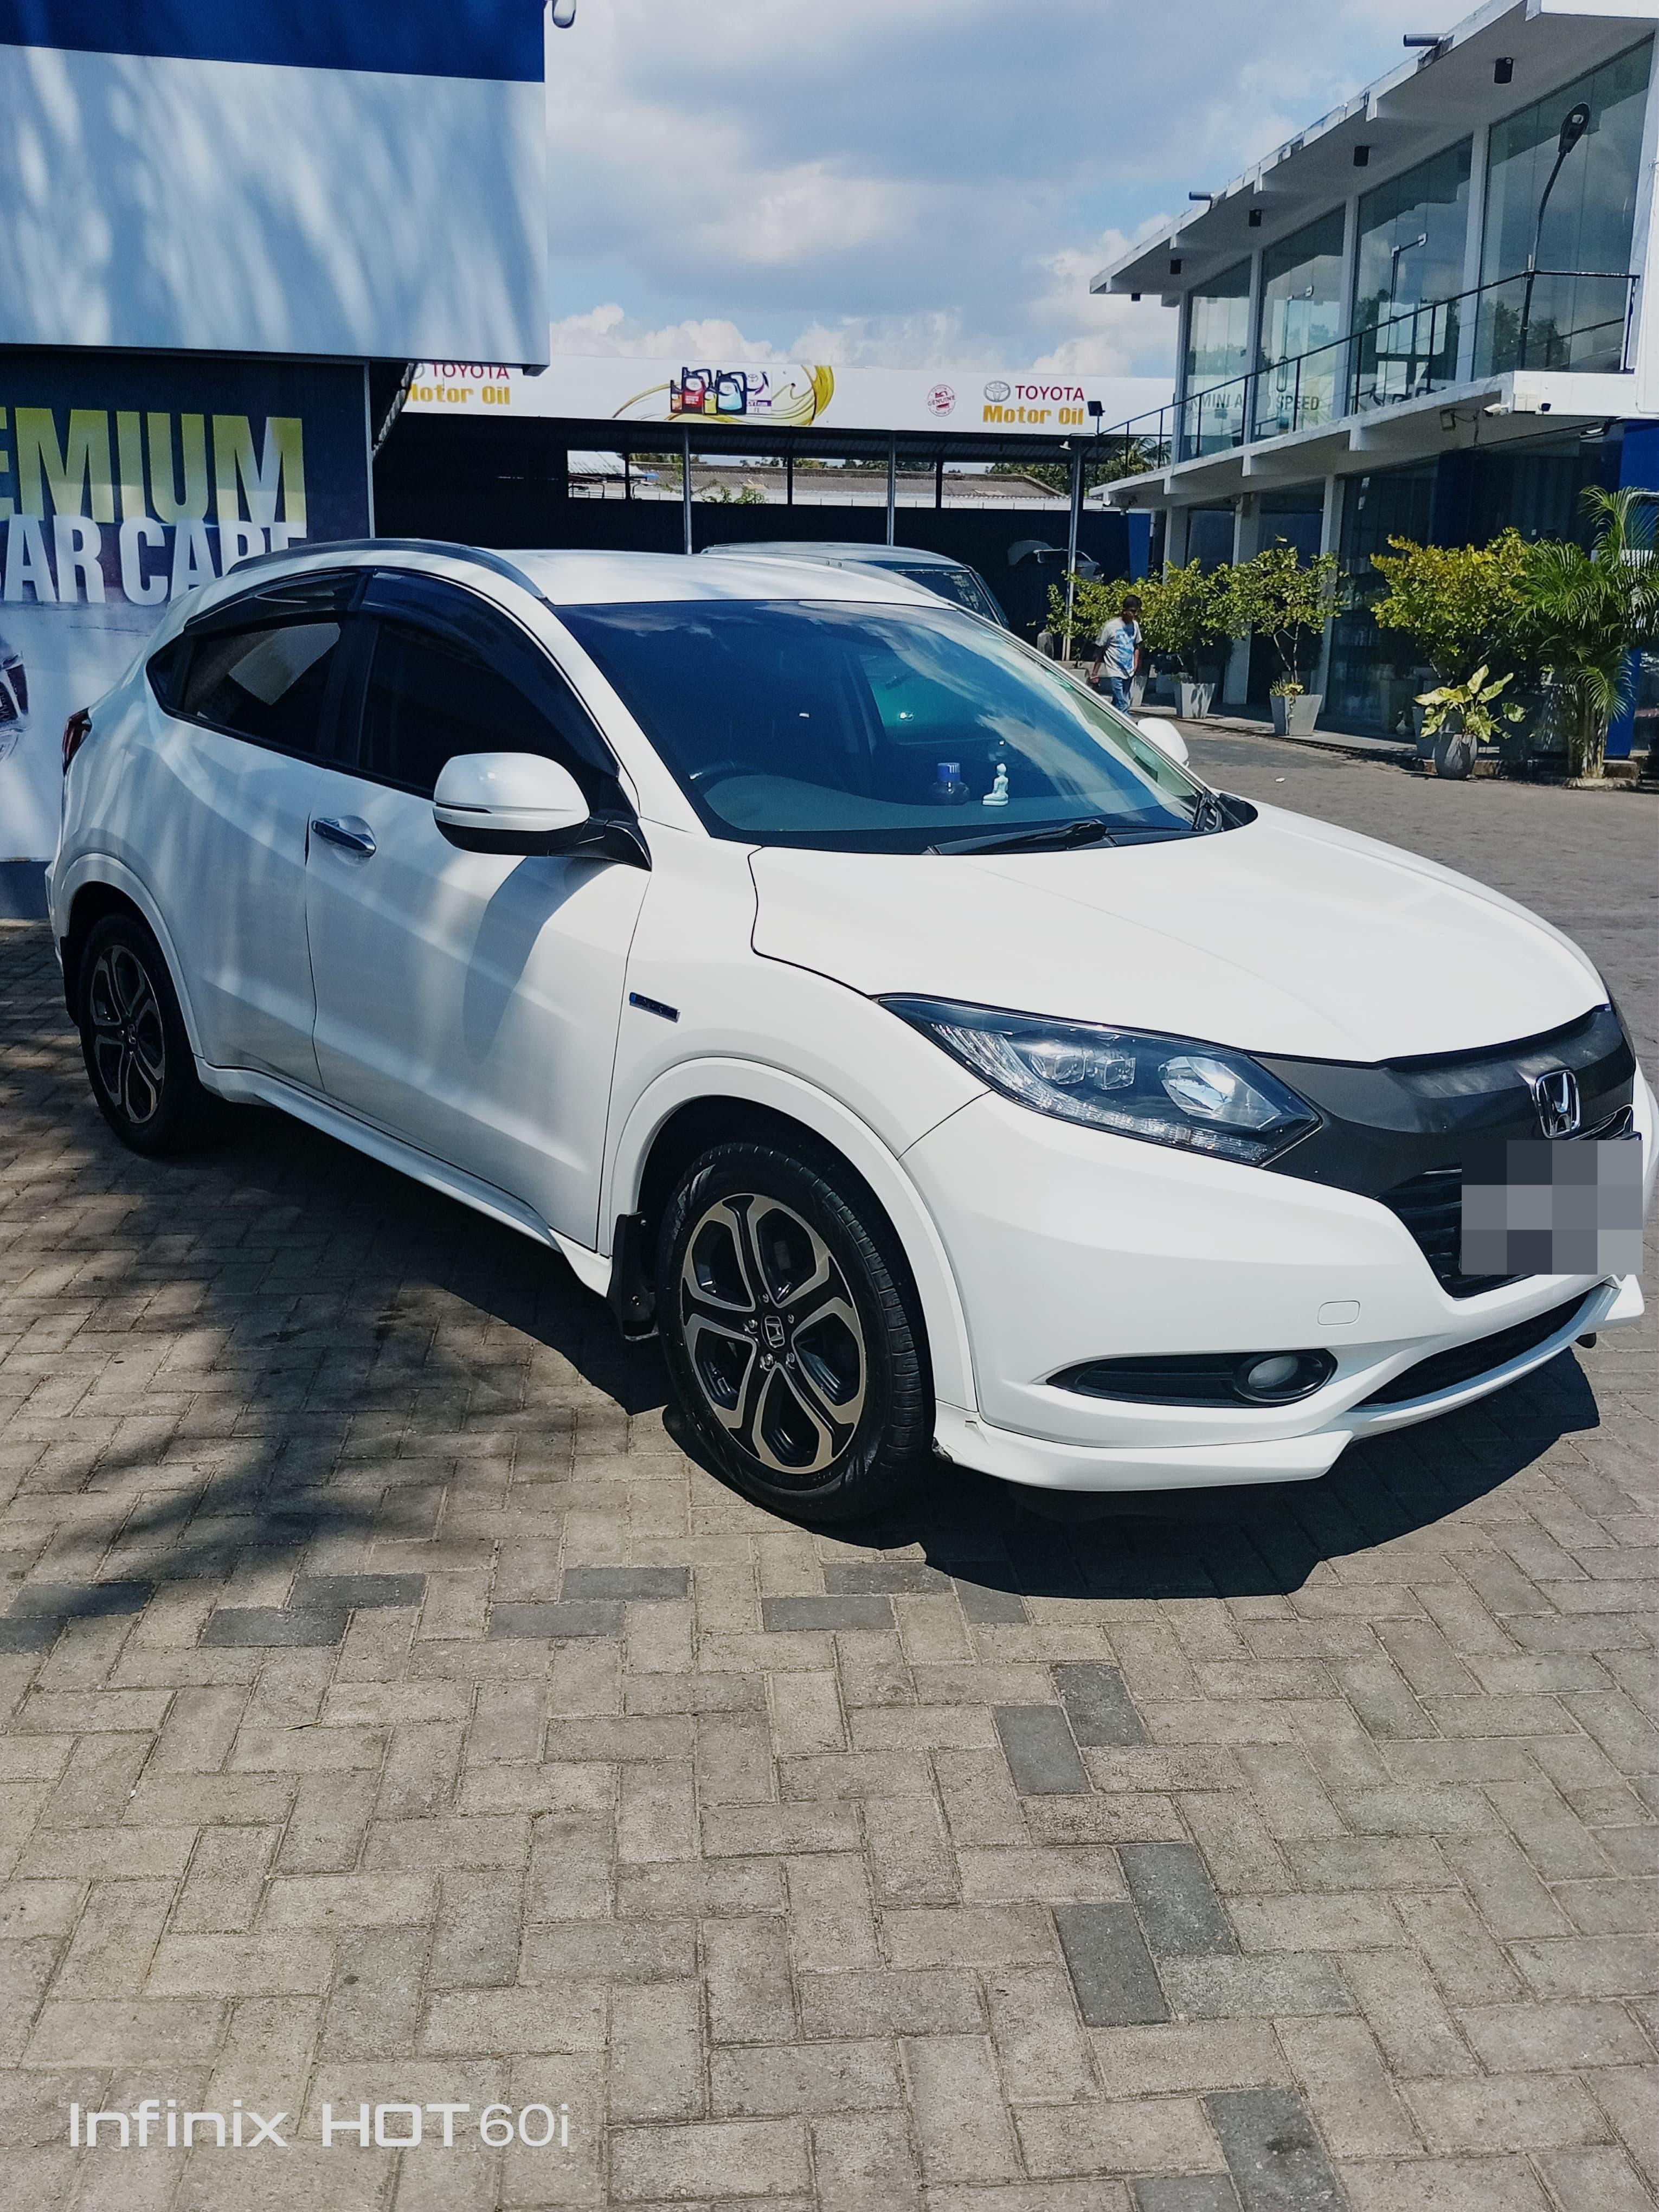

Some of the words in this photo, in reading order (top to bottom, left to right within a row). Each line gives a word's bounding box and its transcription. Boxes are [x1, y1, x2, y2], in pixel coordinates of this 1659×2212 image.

[482, 385, 510, 405] Oil
[928, 394, 956, 406] GENUINE
[1015, 385, 1085, 402] TOYOTA
[983, 405, 1052, 425] Motor
[1058, 407, 1084, 426] Oil
[0, 514, 106, 603] AR
